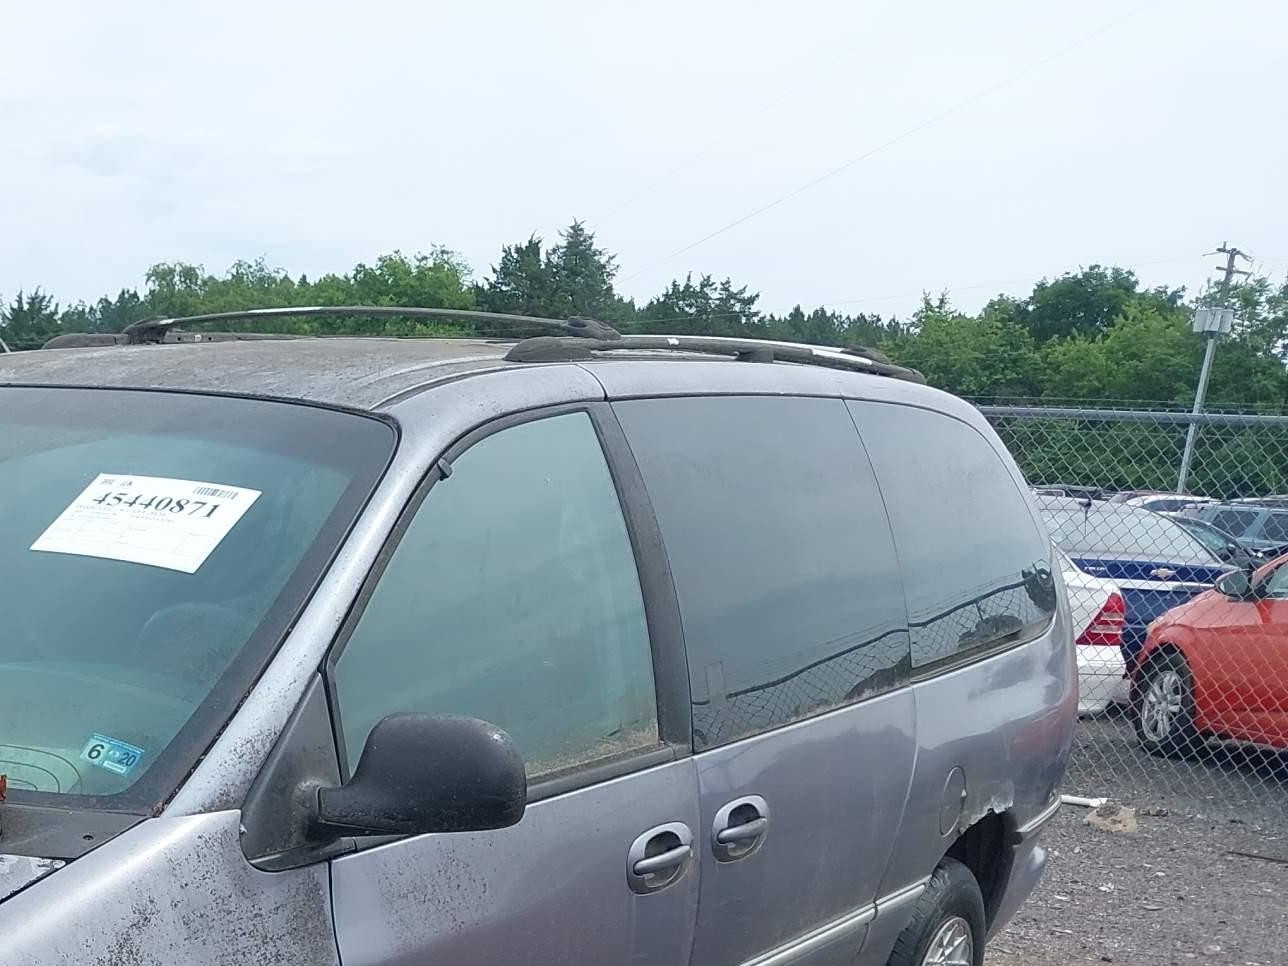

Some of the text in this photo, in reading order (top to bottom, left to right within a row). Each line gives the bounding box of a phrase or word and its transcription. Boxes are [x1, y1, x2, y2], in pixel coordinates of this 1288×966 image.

[92, 491, 220, 518] 45440871
[88, 744, 105, 760] 6
[119, 752, 137, 767] 20
